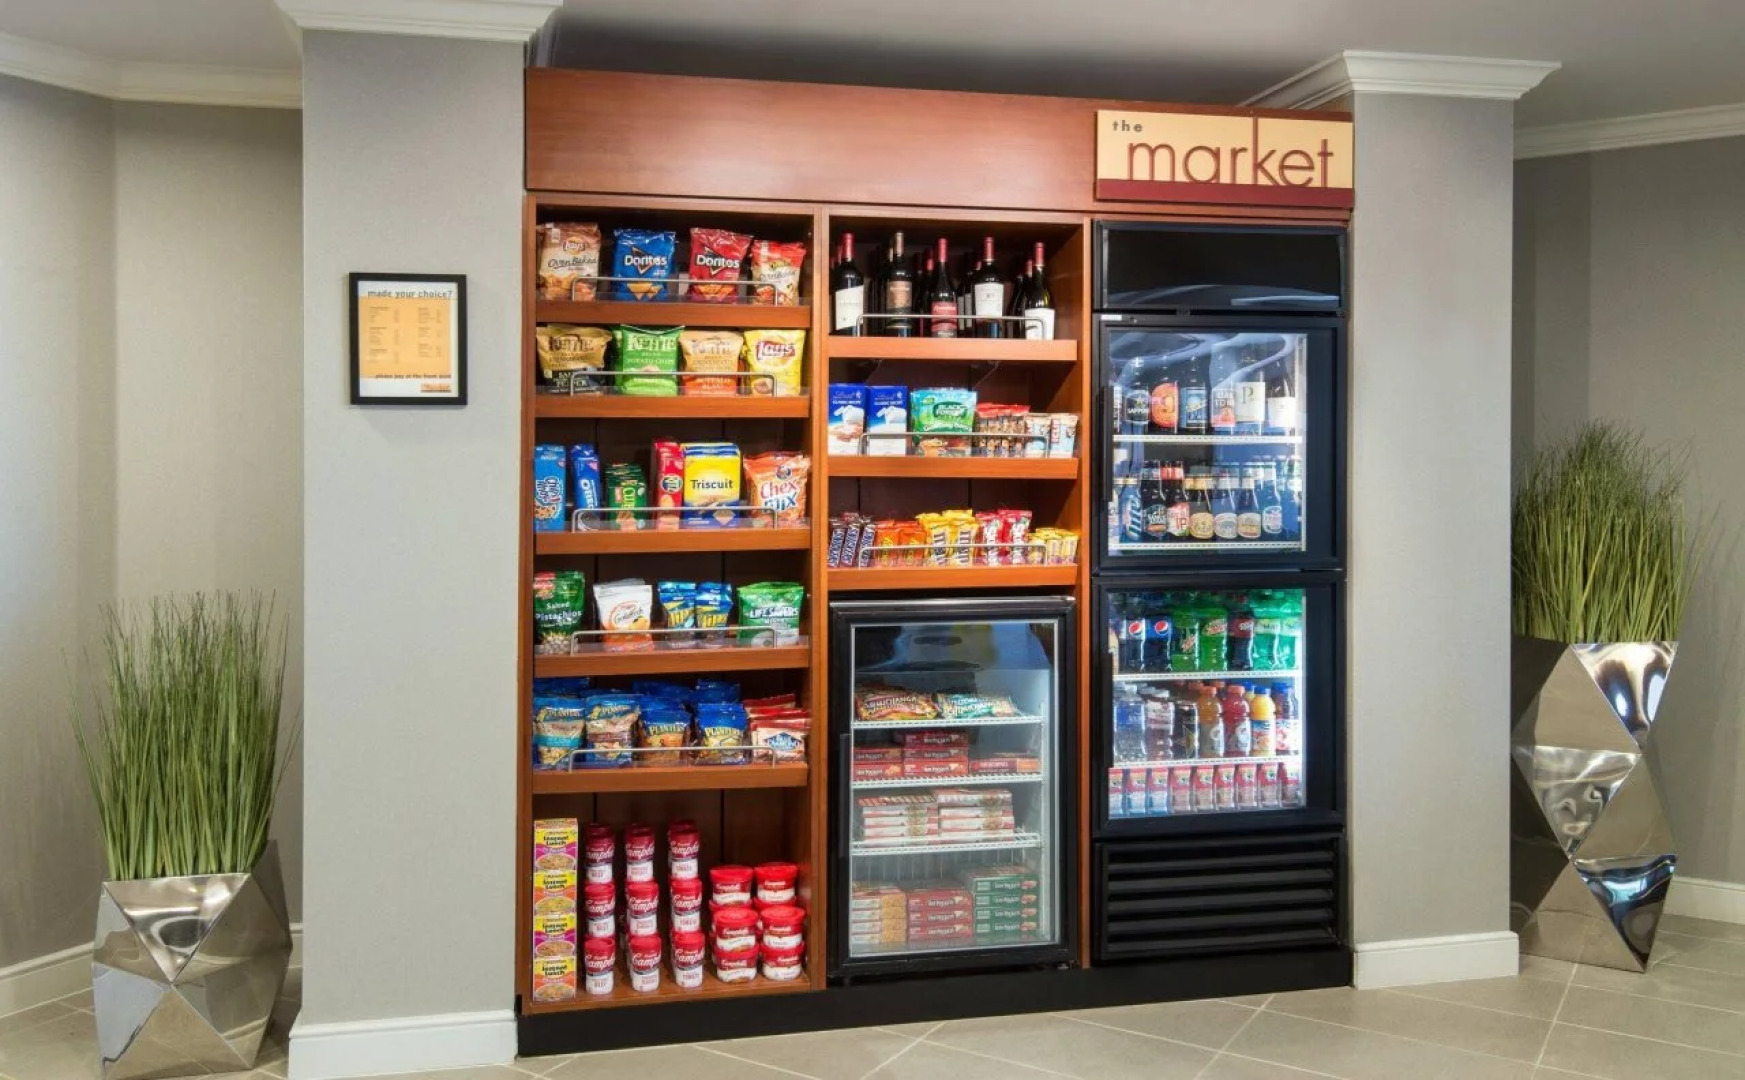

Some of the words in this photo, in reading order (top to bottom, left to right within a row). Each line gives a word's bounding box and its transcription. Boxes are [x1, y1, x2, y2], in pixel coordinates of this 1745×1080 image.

[1112, 119, 1143, 133] the
[1127, 115, 1334, 188] market
[624, 254, 667, 266] Doritos
[696, 254, 740, 268] Doritos
[368, 289, 392, 299] made
[395, 290, 415, 300] your
[418, 290, 452, 299] choice?
[689, 479, 734, 489] Triscuit
[760, 480, 798, 499] Chex
[535, 609, 583, 622] Pistachios
